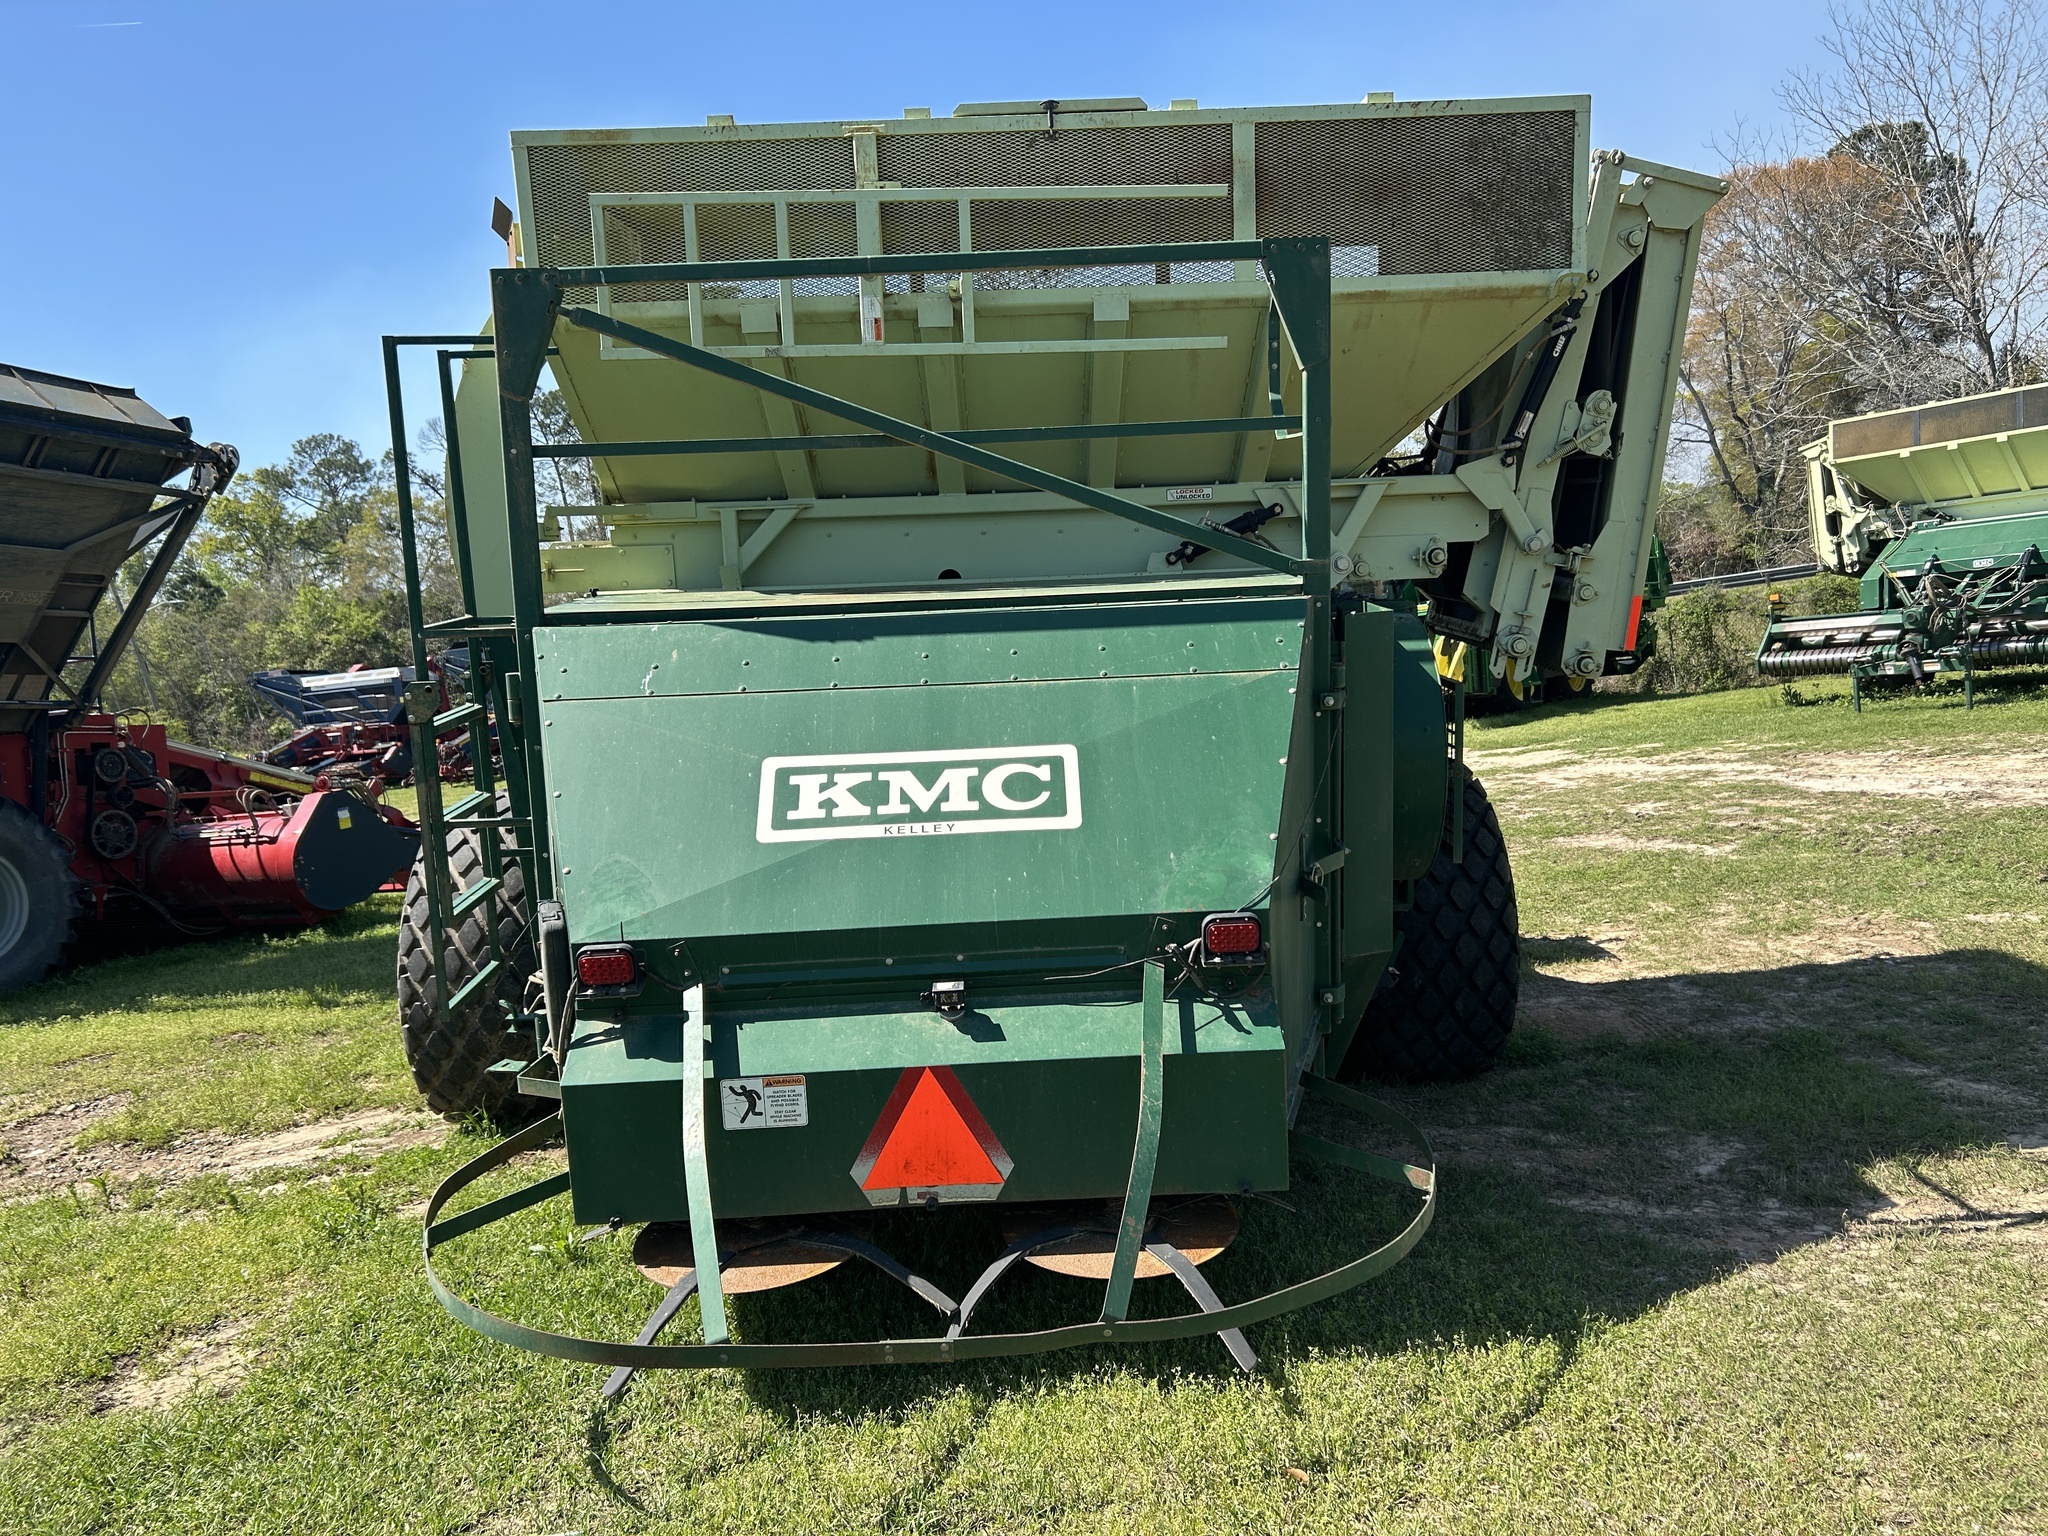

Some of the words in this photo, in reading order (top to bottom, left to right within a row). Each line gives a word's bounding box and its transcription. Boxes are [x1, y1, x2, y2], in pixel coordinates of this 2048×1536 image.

[1552, 334, 1566, 357] CHIEF
[786, 763, 1052, 821] KMC
[883, 823, 956, 835] KELLEY
